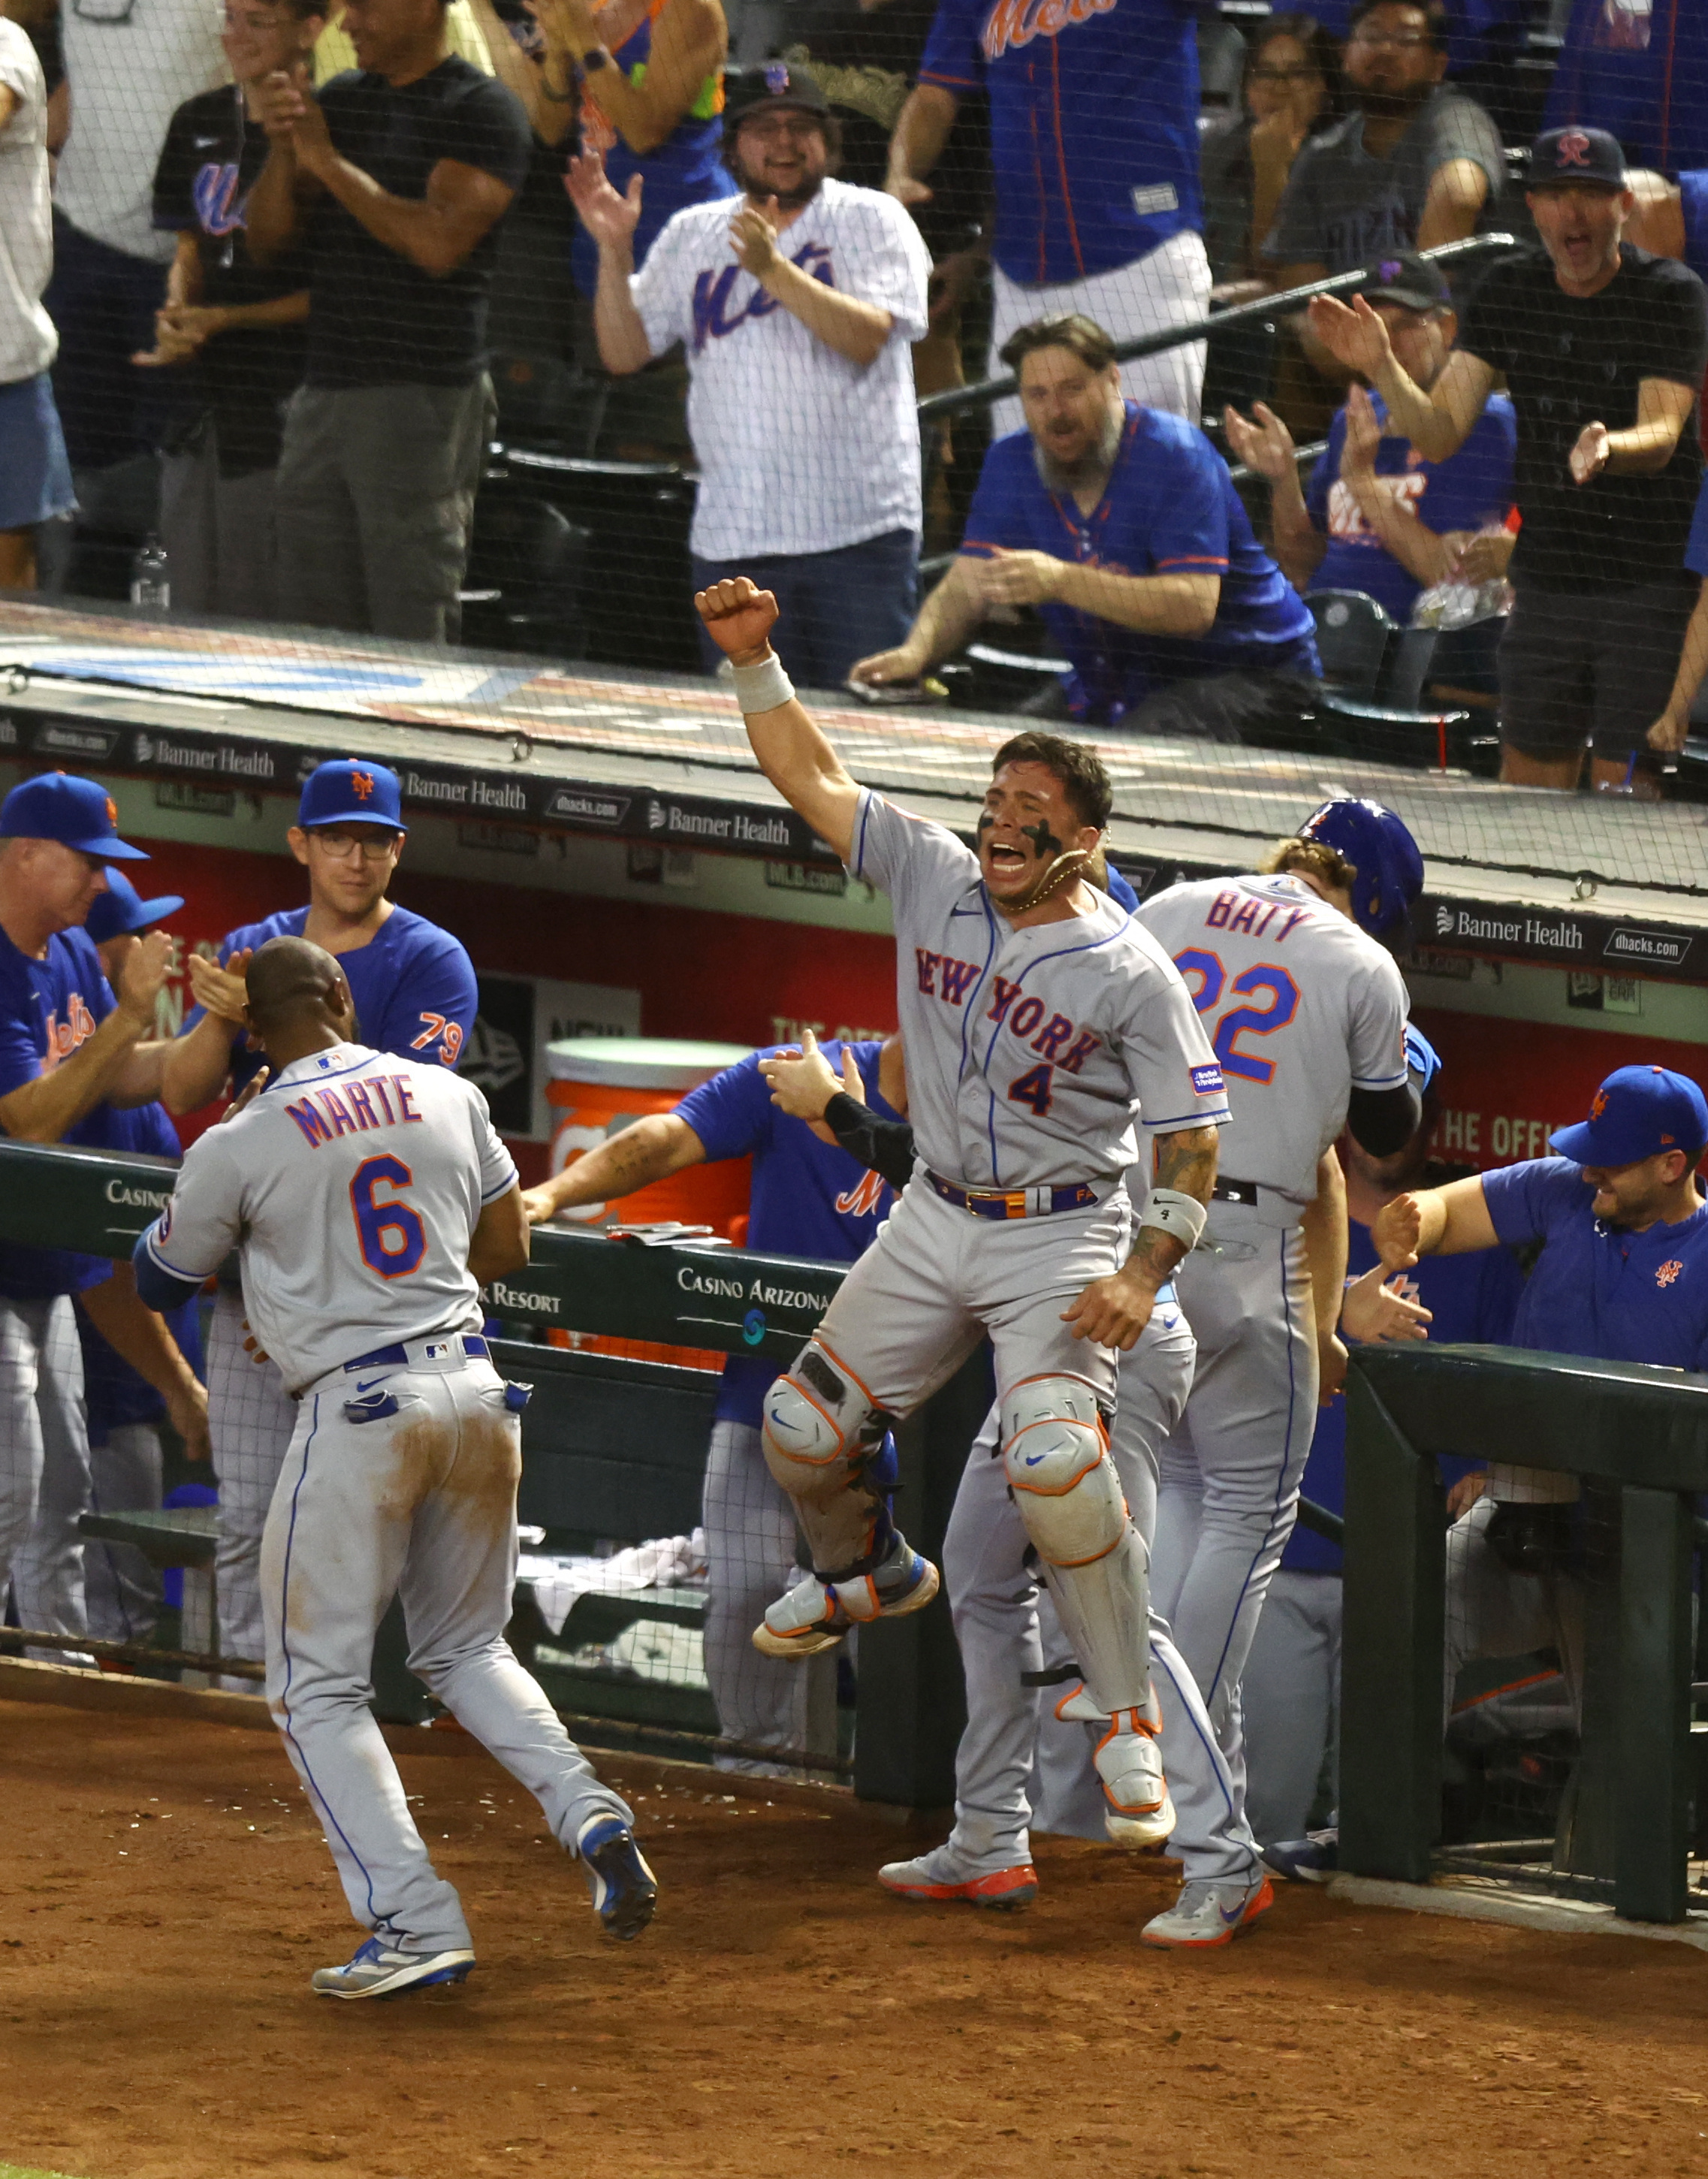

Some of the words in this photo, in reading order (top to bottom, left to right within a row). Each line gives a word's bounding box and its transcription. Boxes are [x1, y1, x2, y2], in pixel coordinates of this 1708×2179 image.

[155, 739, 216, 770] Banner
[221, 747, 275, 778] Health
[408, 772, 469, 802] Banner
[471, 780, 527, 810] Health
[668, 806, 732, 837] Banner
[733, 815, 790, 846] Health
[1205, 889, 1317, 943] BATY
[1457, 911, 1522, 943] Banner
[1524, 919, 1583, 949] Health
[1615, 934, 1679, 958] dbacks.com
[409, 1012, 463, 1065] 79
[986, 975, 1102, 1075] YORK
[1007, 1062, 1055, 1117] 4
[283, 1074, 423, 1149] MARTE
[349, 1153, 429, 1280] 6
[493, 1281, 562, 1313] RESORT
[677, 1267, 744, 1299] CASINO
